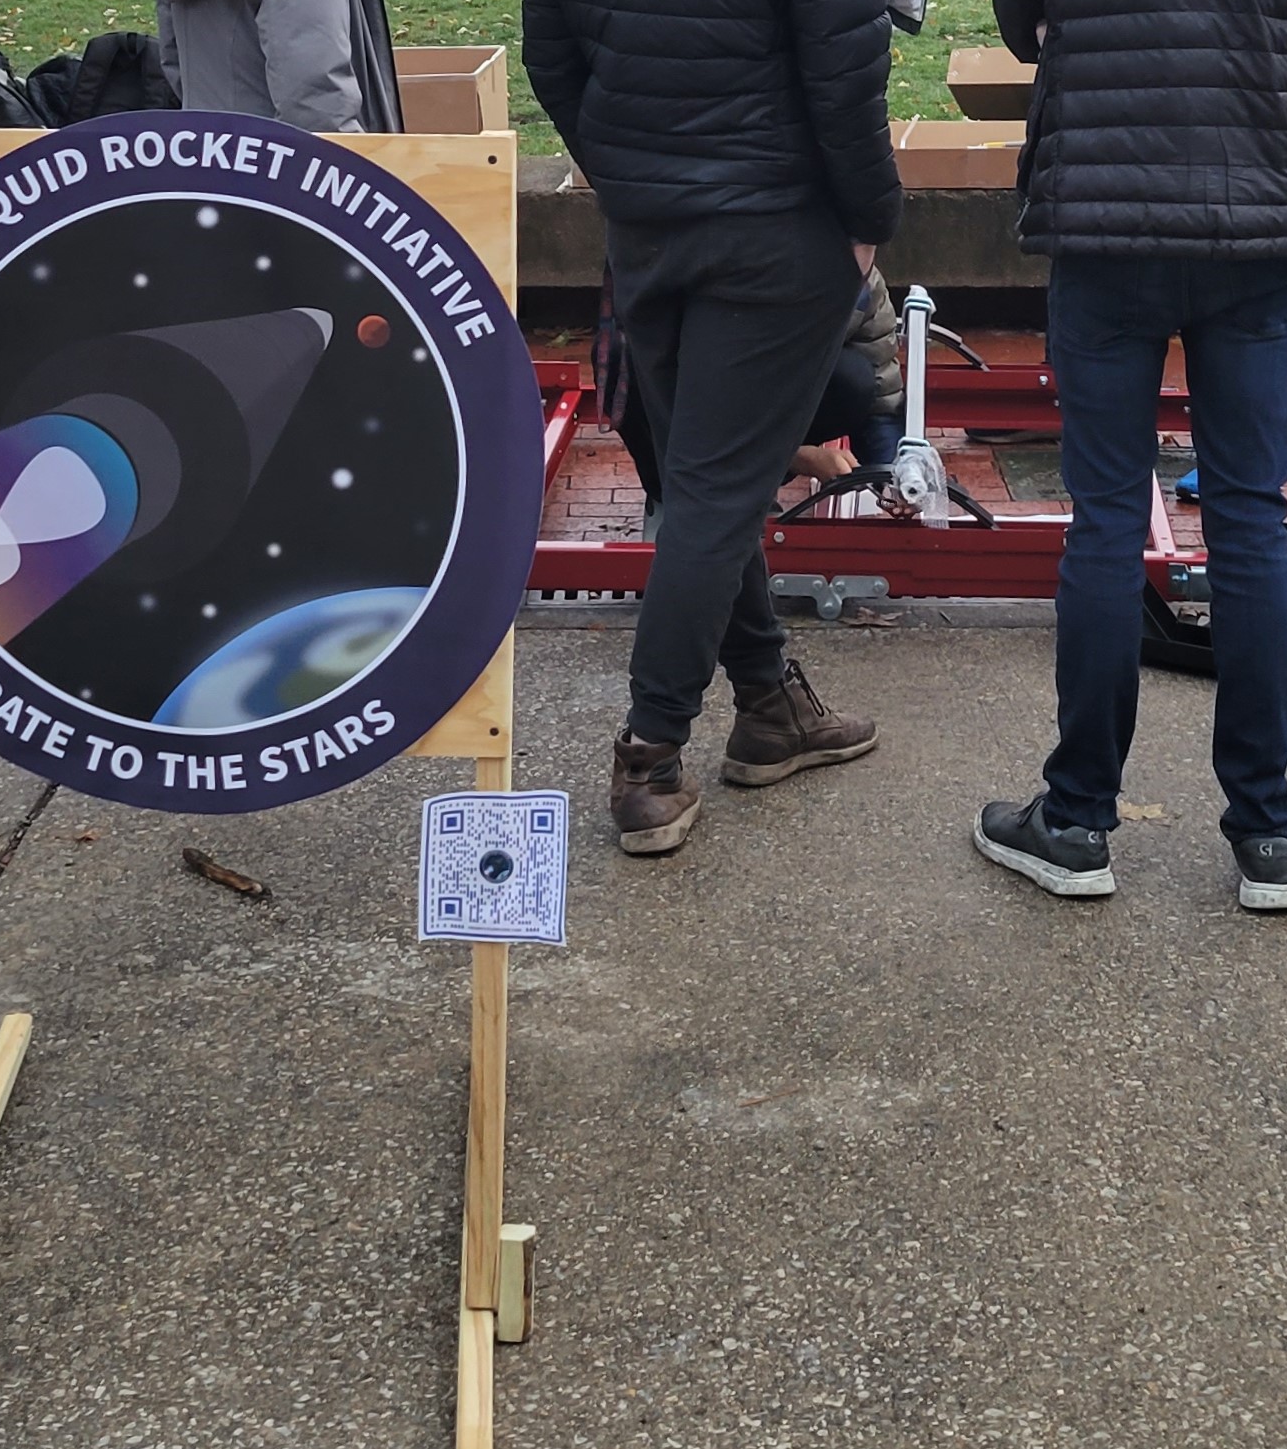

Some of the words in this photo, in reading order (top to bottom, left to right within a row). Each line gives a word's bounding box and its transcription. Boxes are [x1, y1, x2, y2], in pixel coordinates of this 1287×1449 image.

[100, 130, 295, 179] ROCKET
[301, 157, 496, 348] INITIATIVE
[85, 734, 144, 780] TO
[156, 751, 248, 791] THE
[259, 698, 397, 783] STARS
